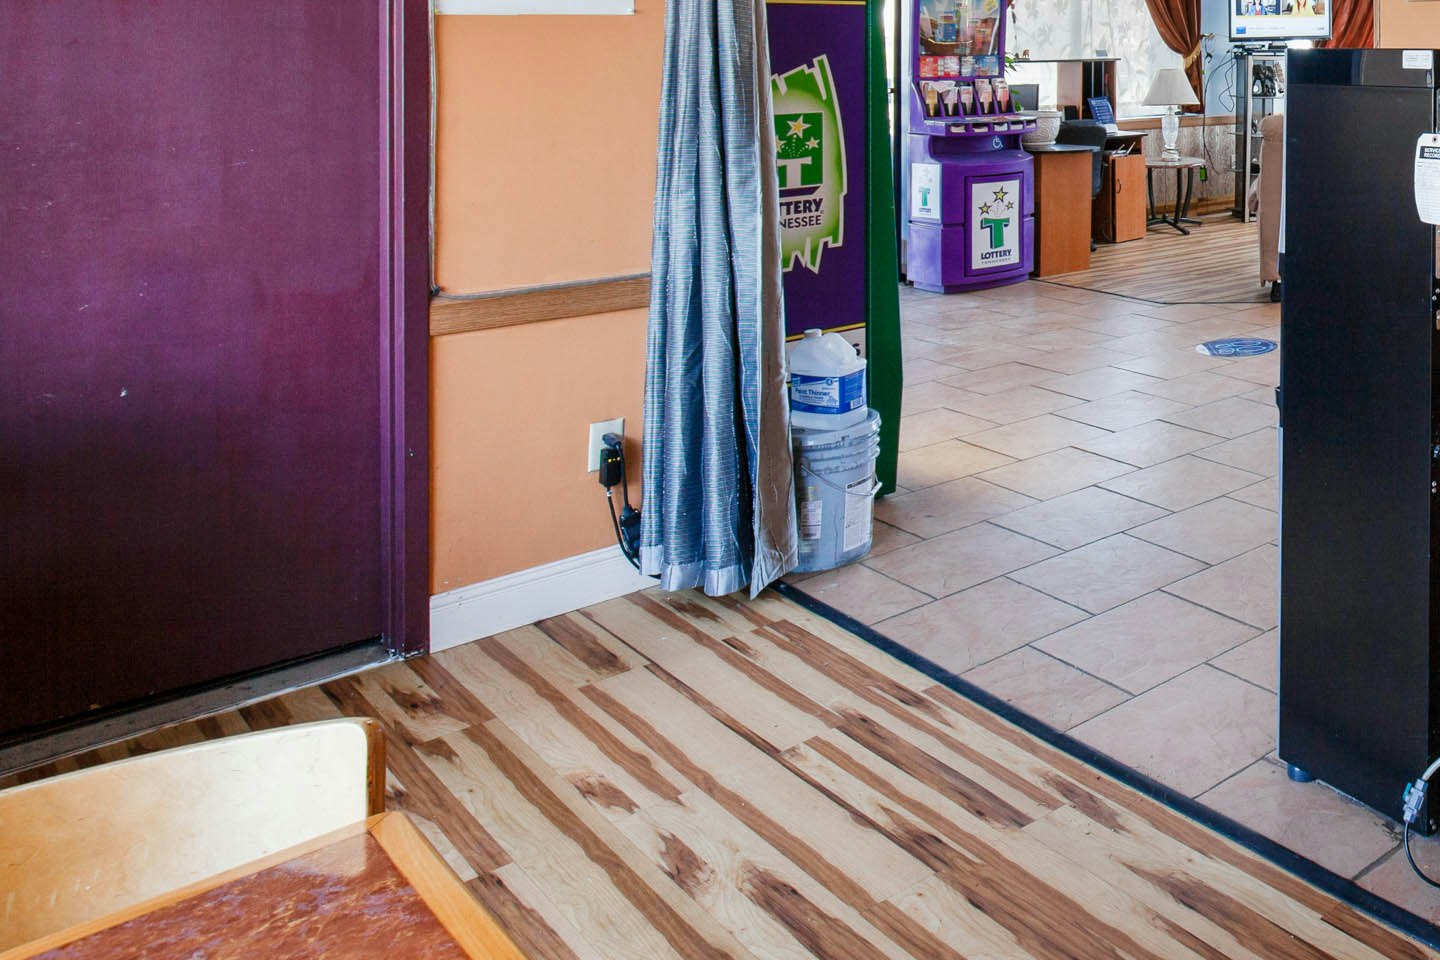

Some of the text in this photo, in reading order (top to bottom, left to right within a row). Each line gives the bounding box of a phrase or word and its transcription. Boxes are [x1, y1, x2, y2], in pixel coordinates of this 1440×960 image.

[780, 198, 823, 216] TERY
[780, 214, 822, 229] NESSEE
[981, 249, 1012, 260] LOTTERY
